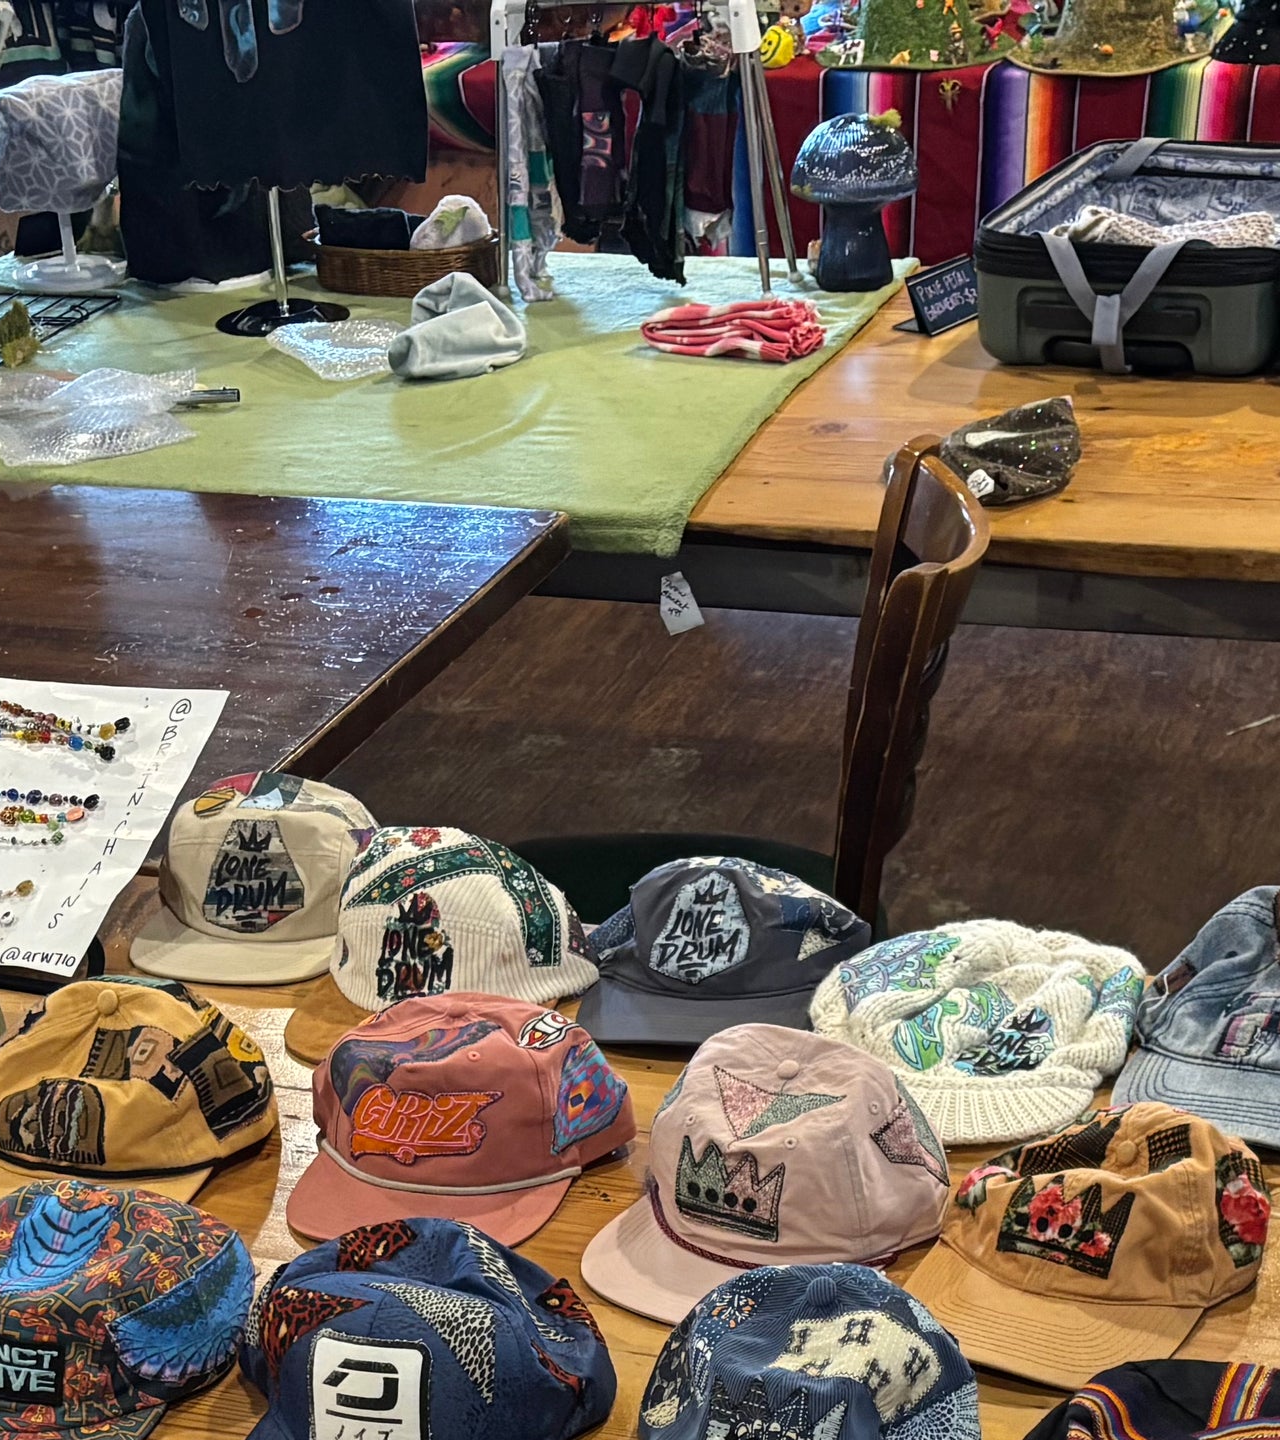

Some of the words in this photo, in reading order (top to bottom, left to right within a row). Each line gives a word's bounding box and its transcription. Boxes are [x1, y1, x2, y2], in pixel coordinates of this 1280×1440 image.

[215, 852, 271, 886] LONE
[213, 871, 288, 917] DRUM
[665, 906, 726, 941] LONE
[656, 929, 742, 968] DRUM
[375, 947, 454, 998] DRUM
